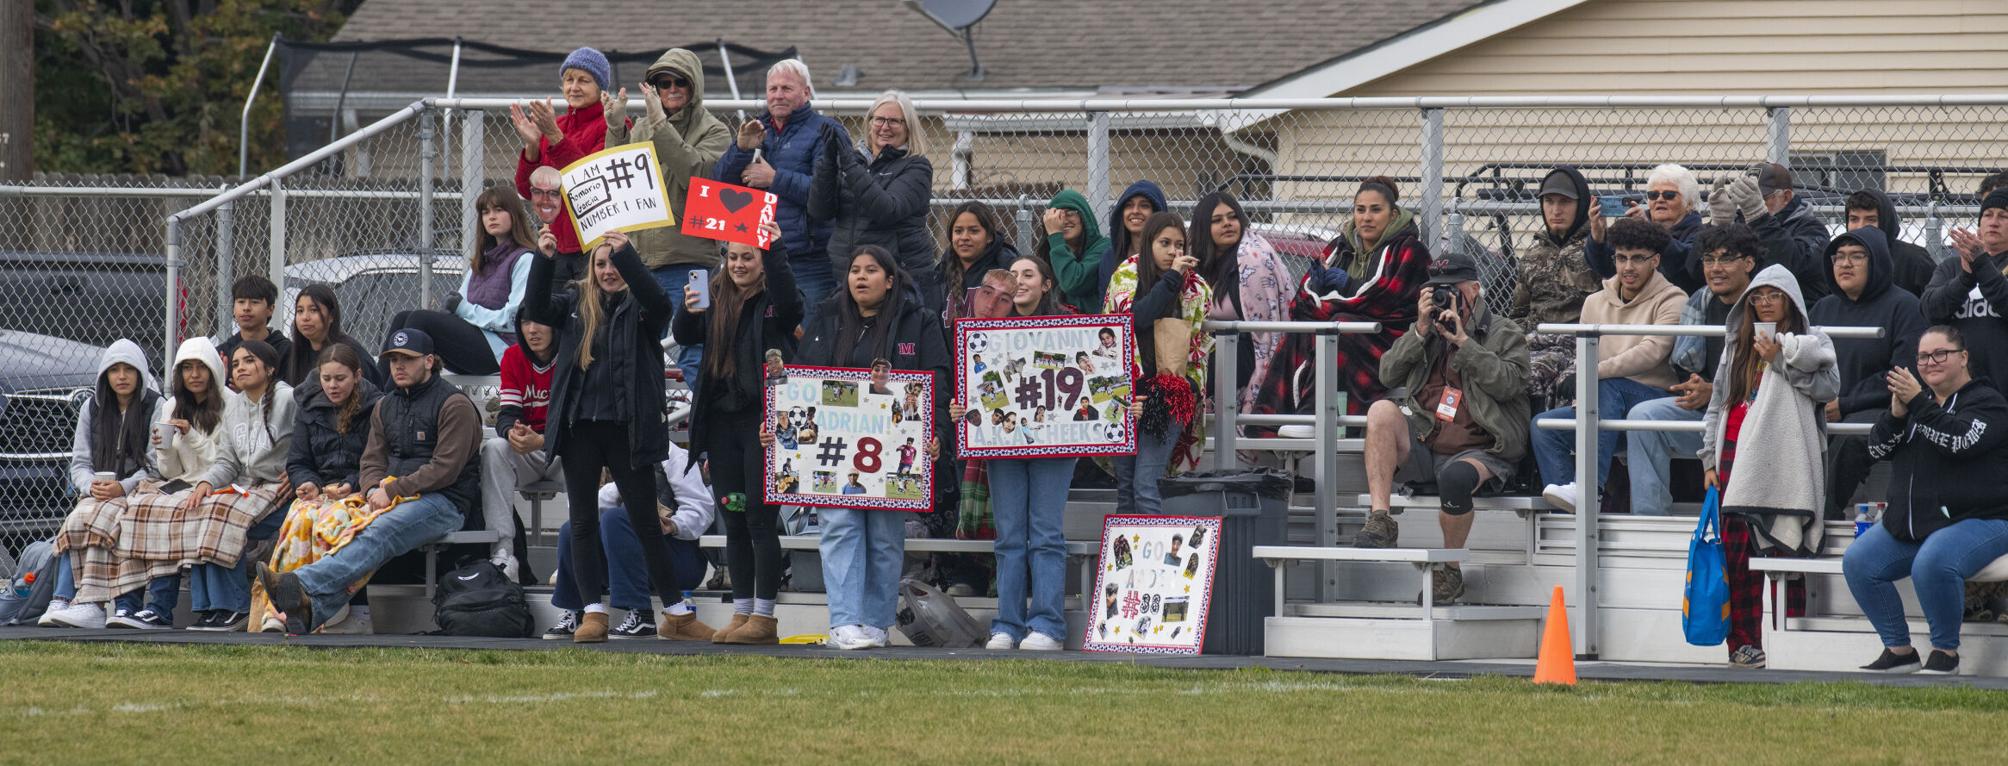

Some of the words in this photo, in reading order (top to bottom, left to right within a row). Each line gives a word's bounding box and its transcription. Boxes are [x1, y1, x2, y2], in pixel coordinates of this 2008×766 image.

[570, 174, 577, 186] I
[583, 163, 601, 181] AM
[568, 182, 602, 202] Romario
[699, 184, 711, 198] I
[576, 194, 600, 214] Garcia
[580, 202, 621, 232] NUMBER
[636, 197, 658, 211] FAN
[688, 215, 726, 231] #21
[898, 342, 916, 356] M
[988, 328, 1098, 352] GIOVANNY
[786, 381, 817, 402] GO
[1014, 366, 1085, 412] #19
[815, 408, 891, 435] ADRIAN!
[1033, 423, 1103, 446] CHEEKS
[1142, 540, 1164, 561] GO
